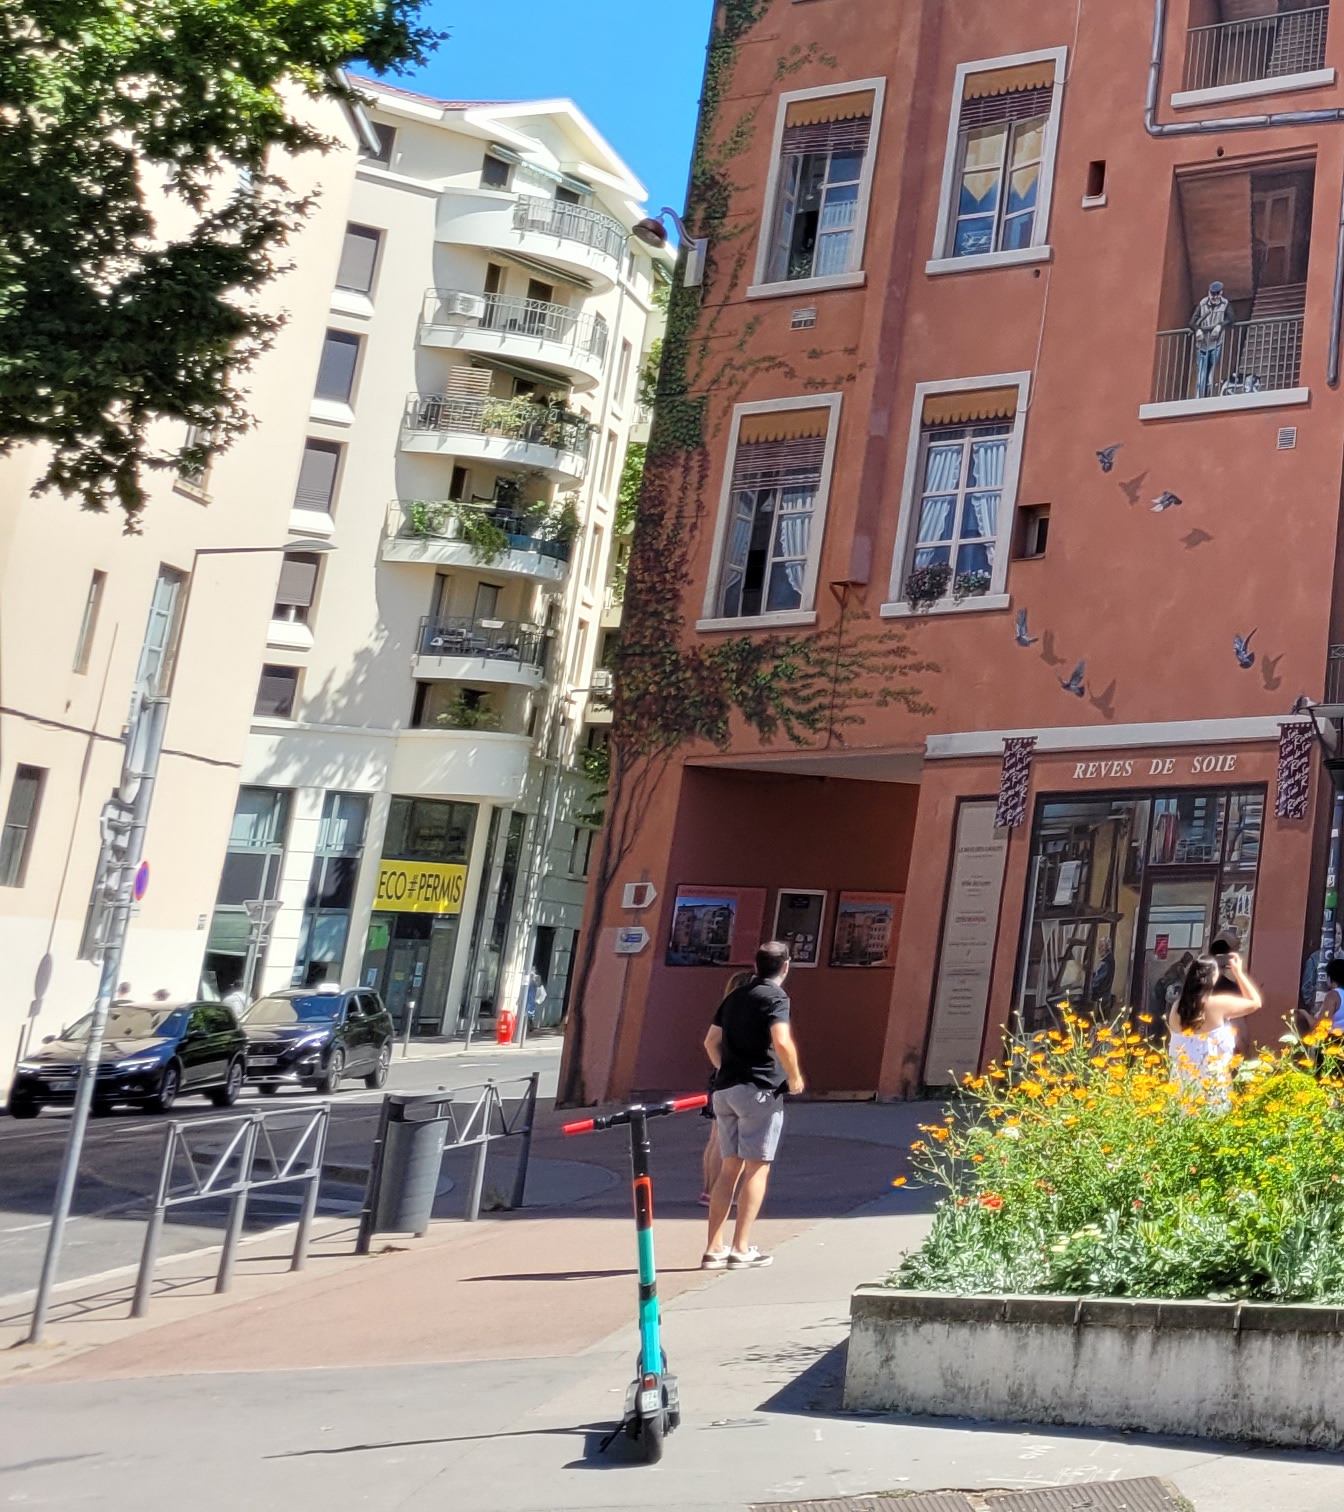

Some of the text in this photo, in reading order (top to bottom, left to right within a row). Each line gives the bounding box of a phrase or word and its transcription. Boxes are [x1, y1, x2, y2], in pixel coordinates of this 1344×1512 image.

[1072, 755, 1237, 779] REVES DE SOIE
[377, 871, 407, 901] ECO
[417, 873, 463, 904] PERMIS
